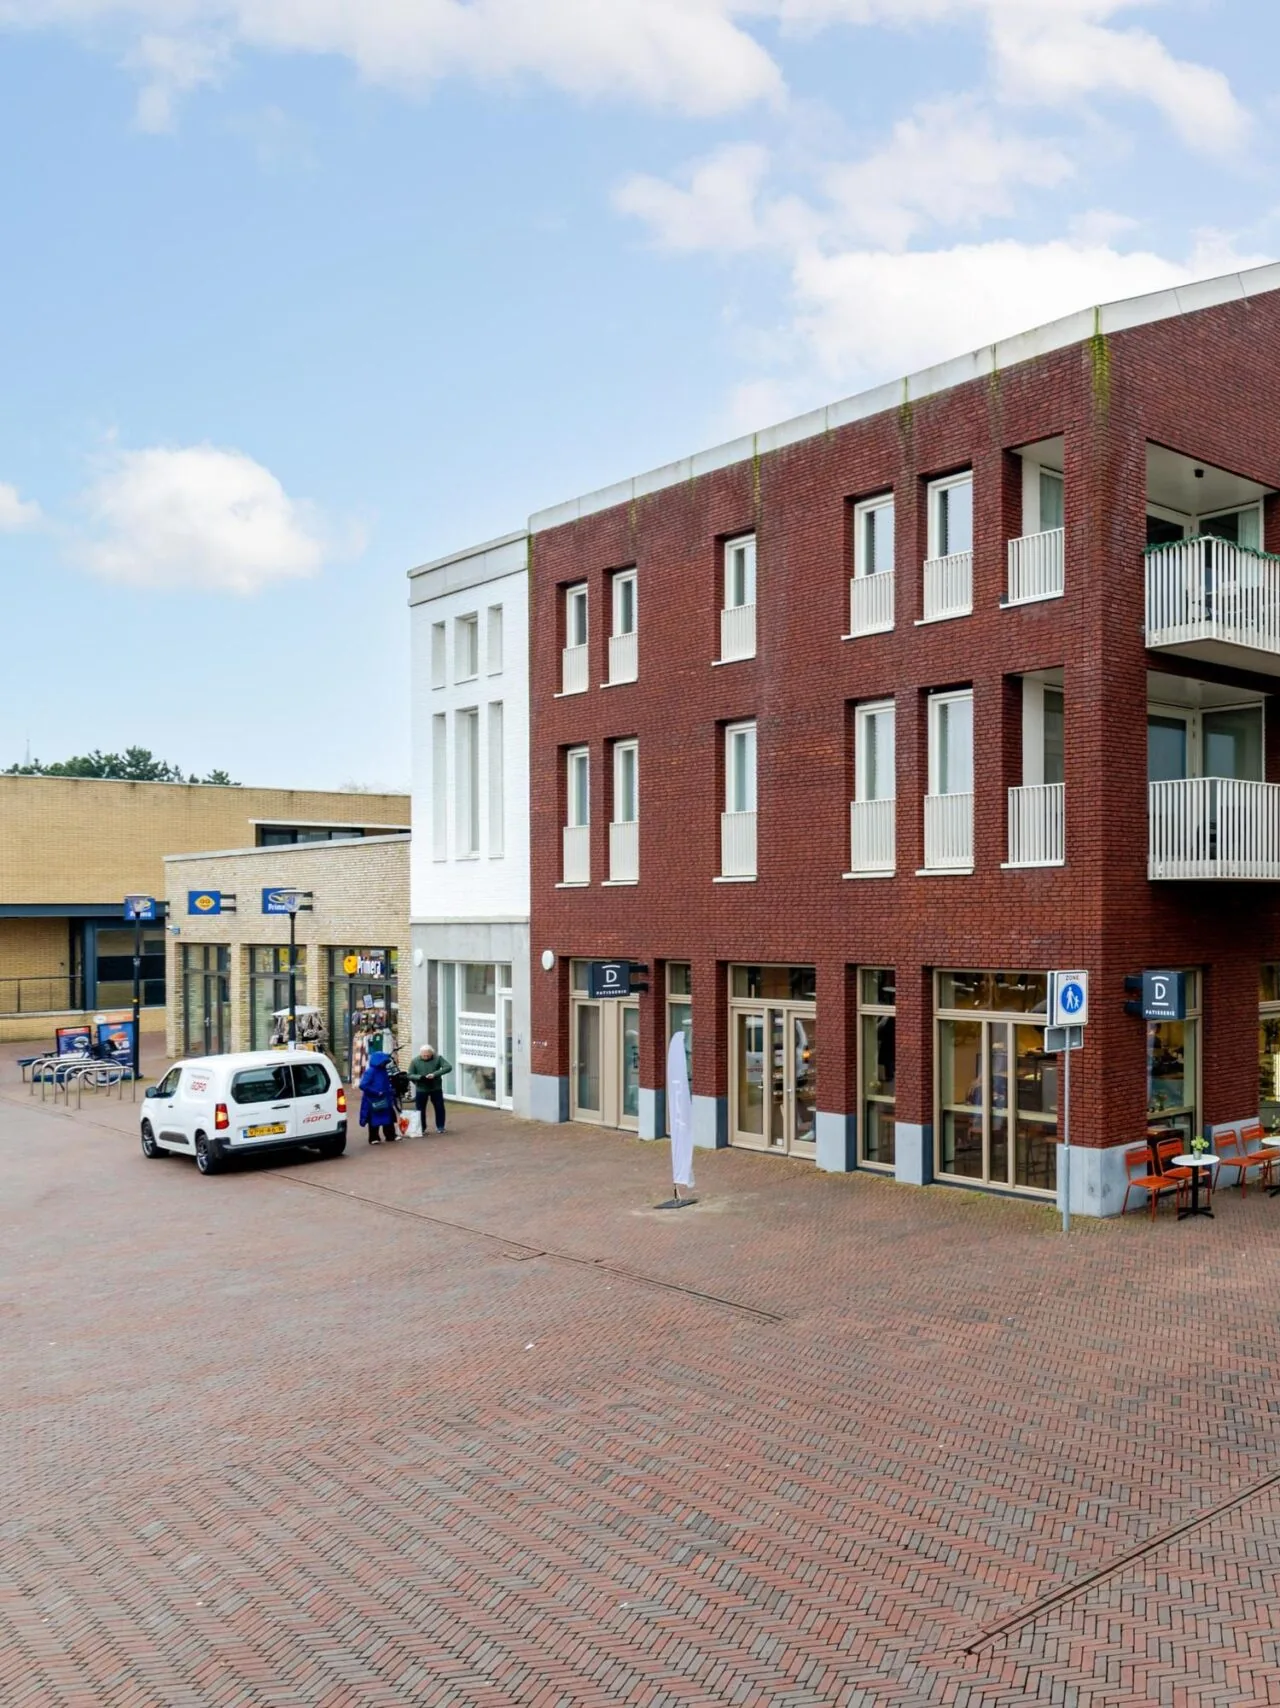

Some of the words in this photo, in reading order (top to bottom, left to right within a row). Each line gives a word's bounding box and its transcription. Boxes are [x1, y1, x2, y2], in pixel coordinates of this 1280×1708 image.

[605, 969, 618, 983] D
[1154, 982, 1166, 1000] D
[1145, 1008, 1176, 1017] PATISSERIE
